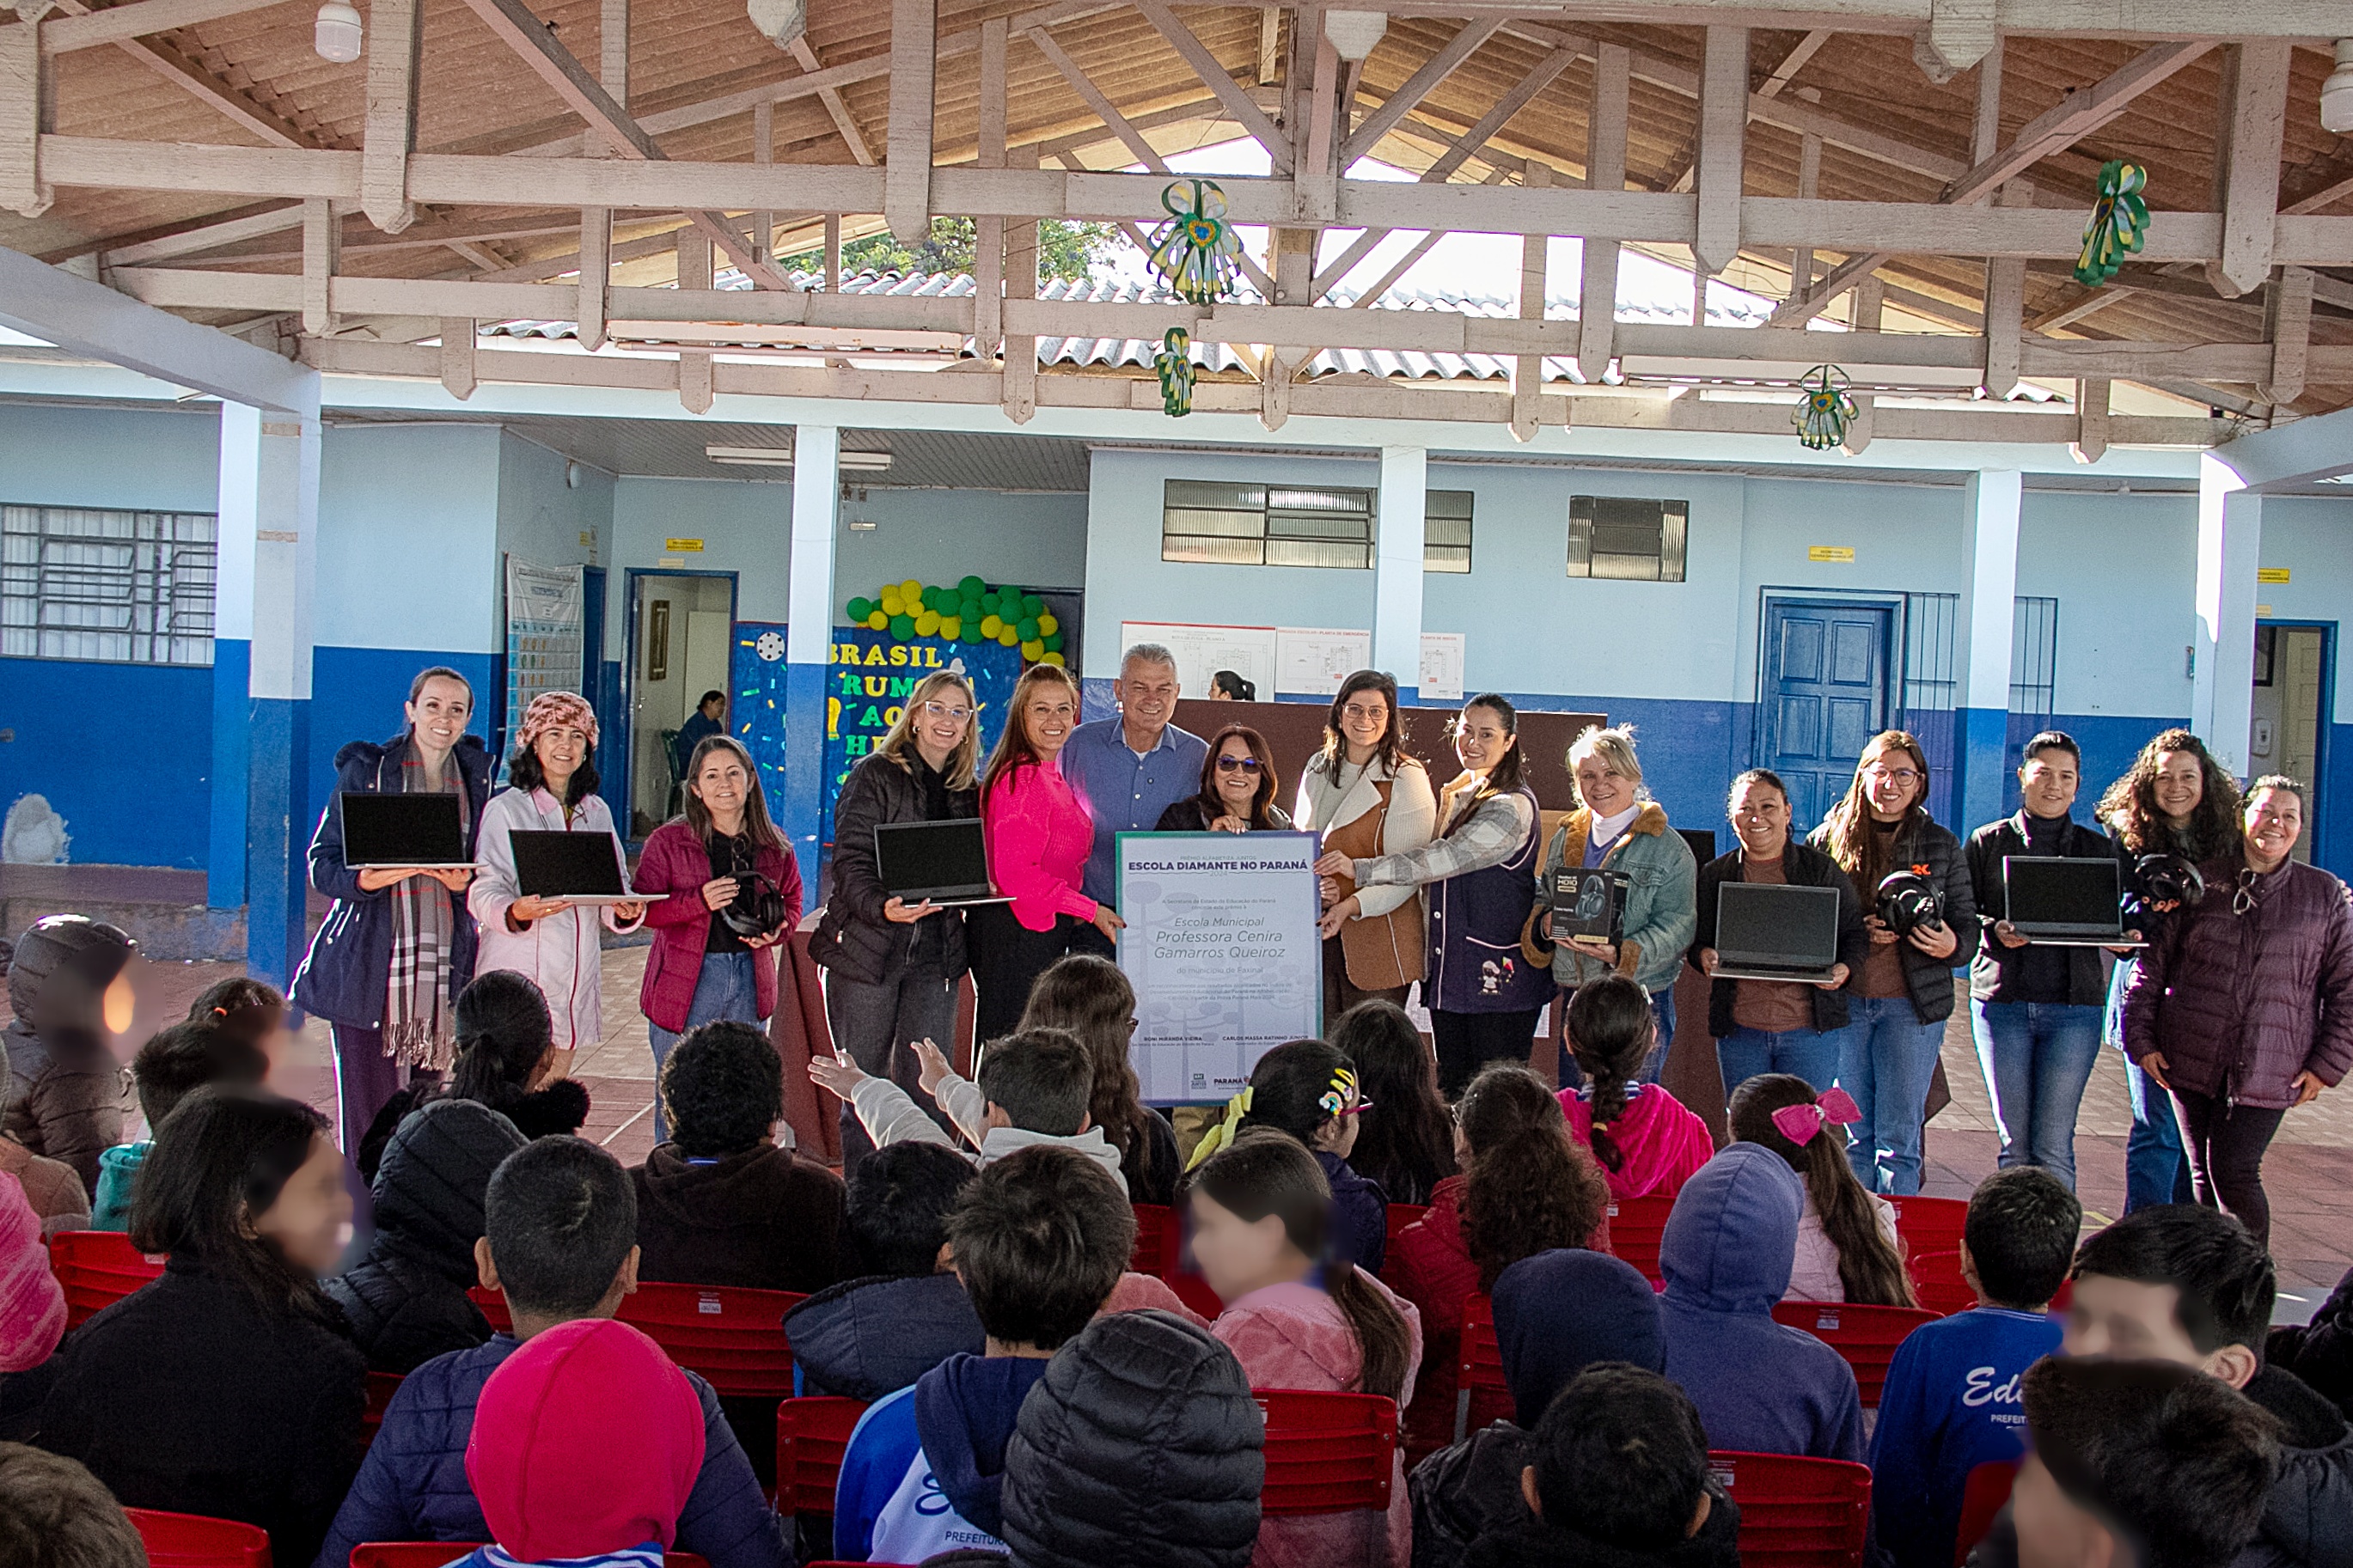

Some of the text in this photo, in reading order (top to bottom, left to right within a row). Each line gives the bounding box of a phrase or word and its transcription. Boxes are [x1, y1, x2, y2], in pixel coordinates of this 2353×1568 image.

[842, 674, 926, 697] RUM
[1129, 859, 1308, 870] ESCOLA DIAMANTE NO PARANÁ
[1175, 917, 1264, 928] Escola Municipal
[1156, 930, 1283, 943] Professora Cenira
[1154, 946, 1285, 958] Gamarros Queiroz
[1991, 1414, 2028, 1424] PREFEIT
